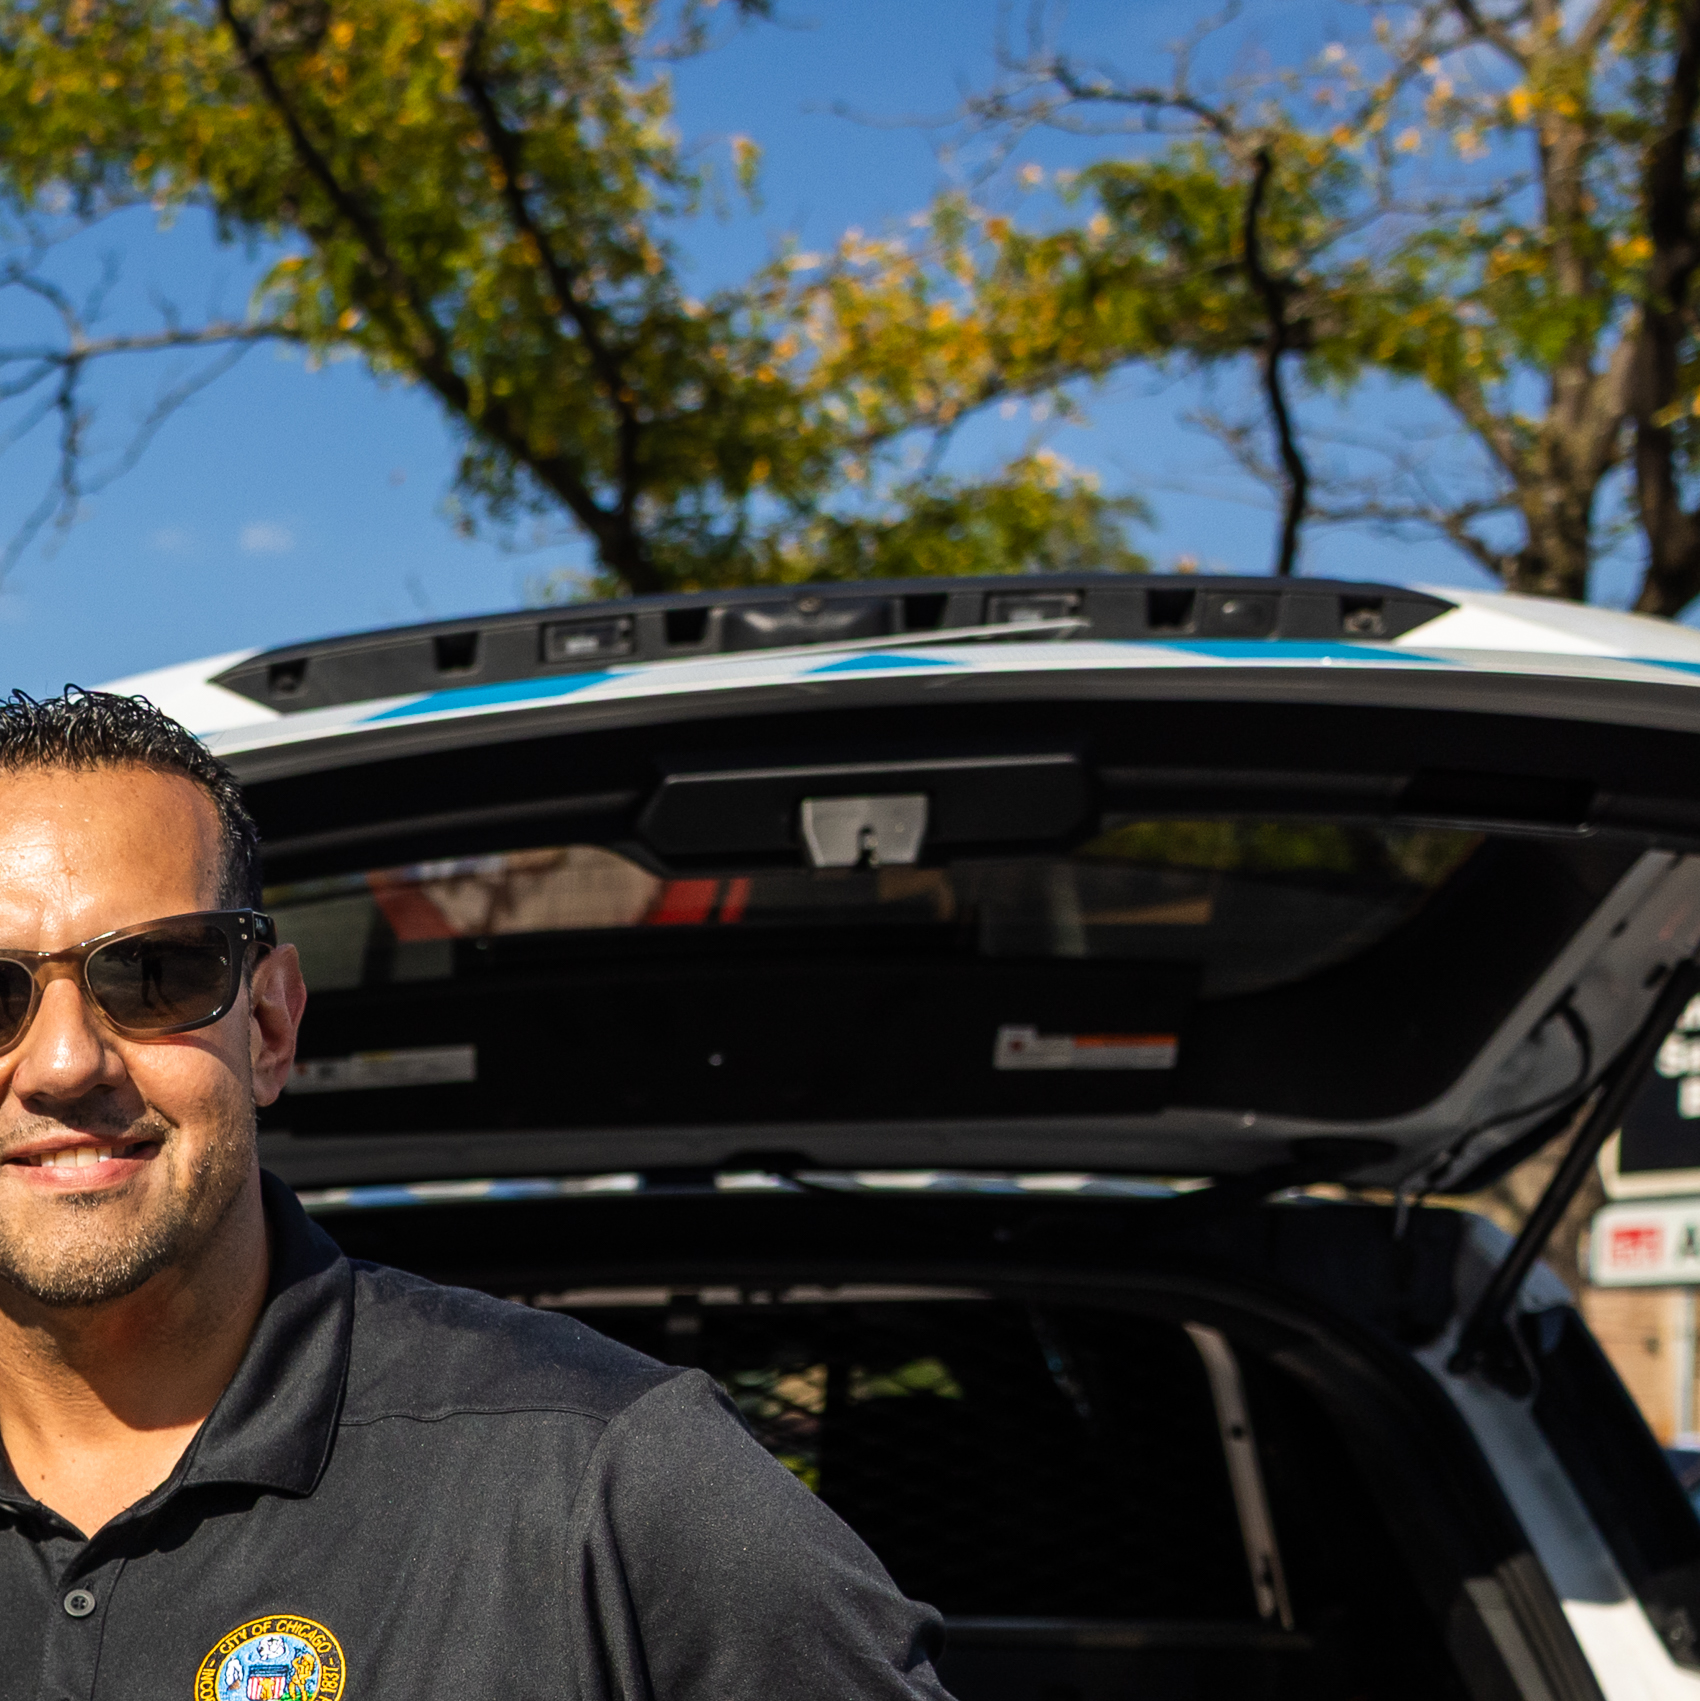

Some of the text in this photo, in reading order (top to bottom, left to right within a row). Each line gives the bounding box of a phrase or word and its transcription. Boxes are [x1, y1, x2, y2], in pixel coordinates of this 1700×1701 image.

[219, 1619, 333, 1655] CITY OF CHICAGO
[320, 1665, 340, 1694] 1837
